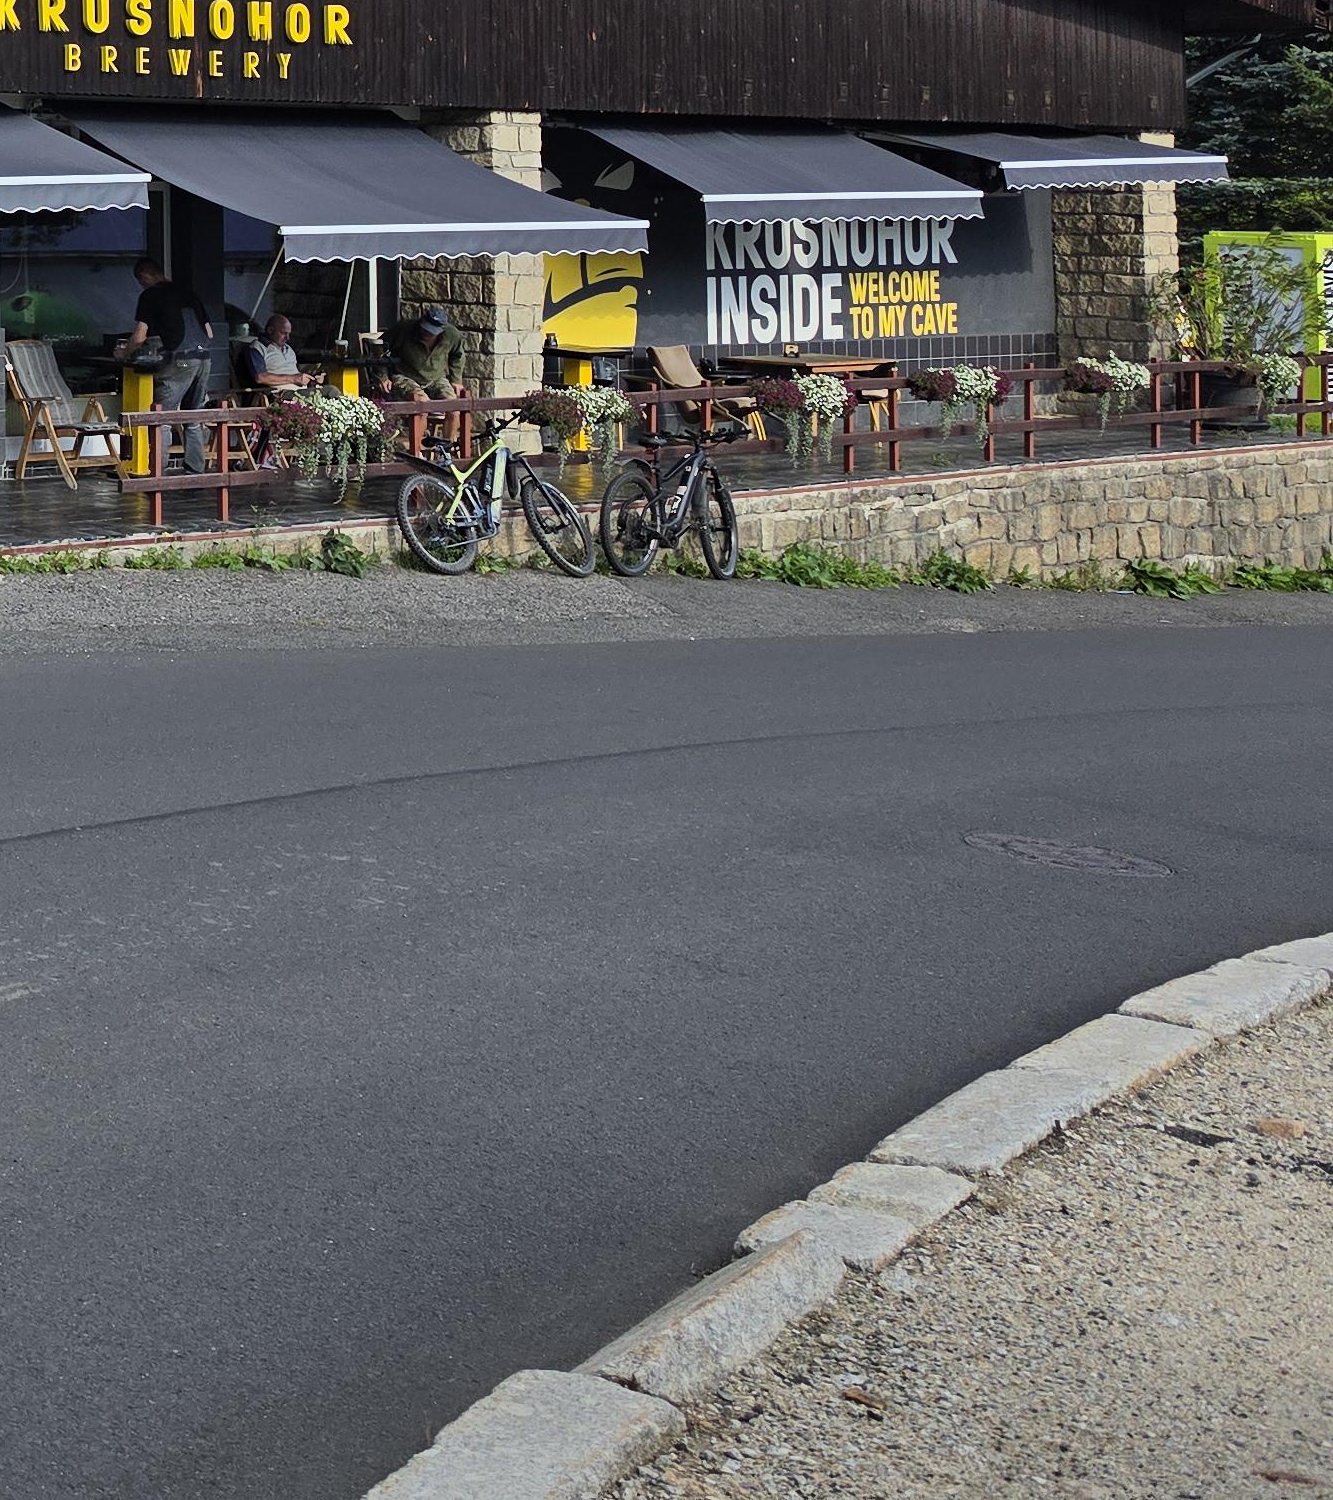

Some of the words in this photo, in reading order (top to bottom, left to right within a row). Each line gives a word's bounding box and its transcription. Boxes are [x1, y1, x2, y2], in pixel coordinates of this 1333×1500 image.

[64, 43, 292, 79] BREWERY
[848, 269, 941, 305] WELCOME
[706, 272, 844, 345] INSIDE
[849, 306, 873, 340] TO
[878, 304, 908, 339] MY
[911, 302, 958, 337] CAVE
